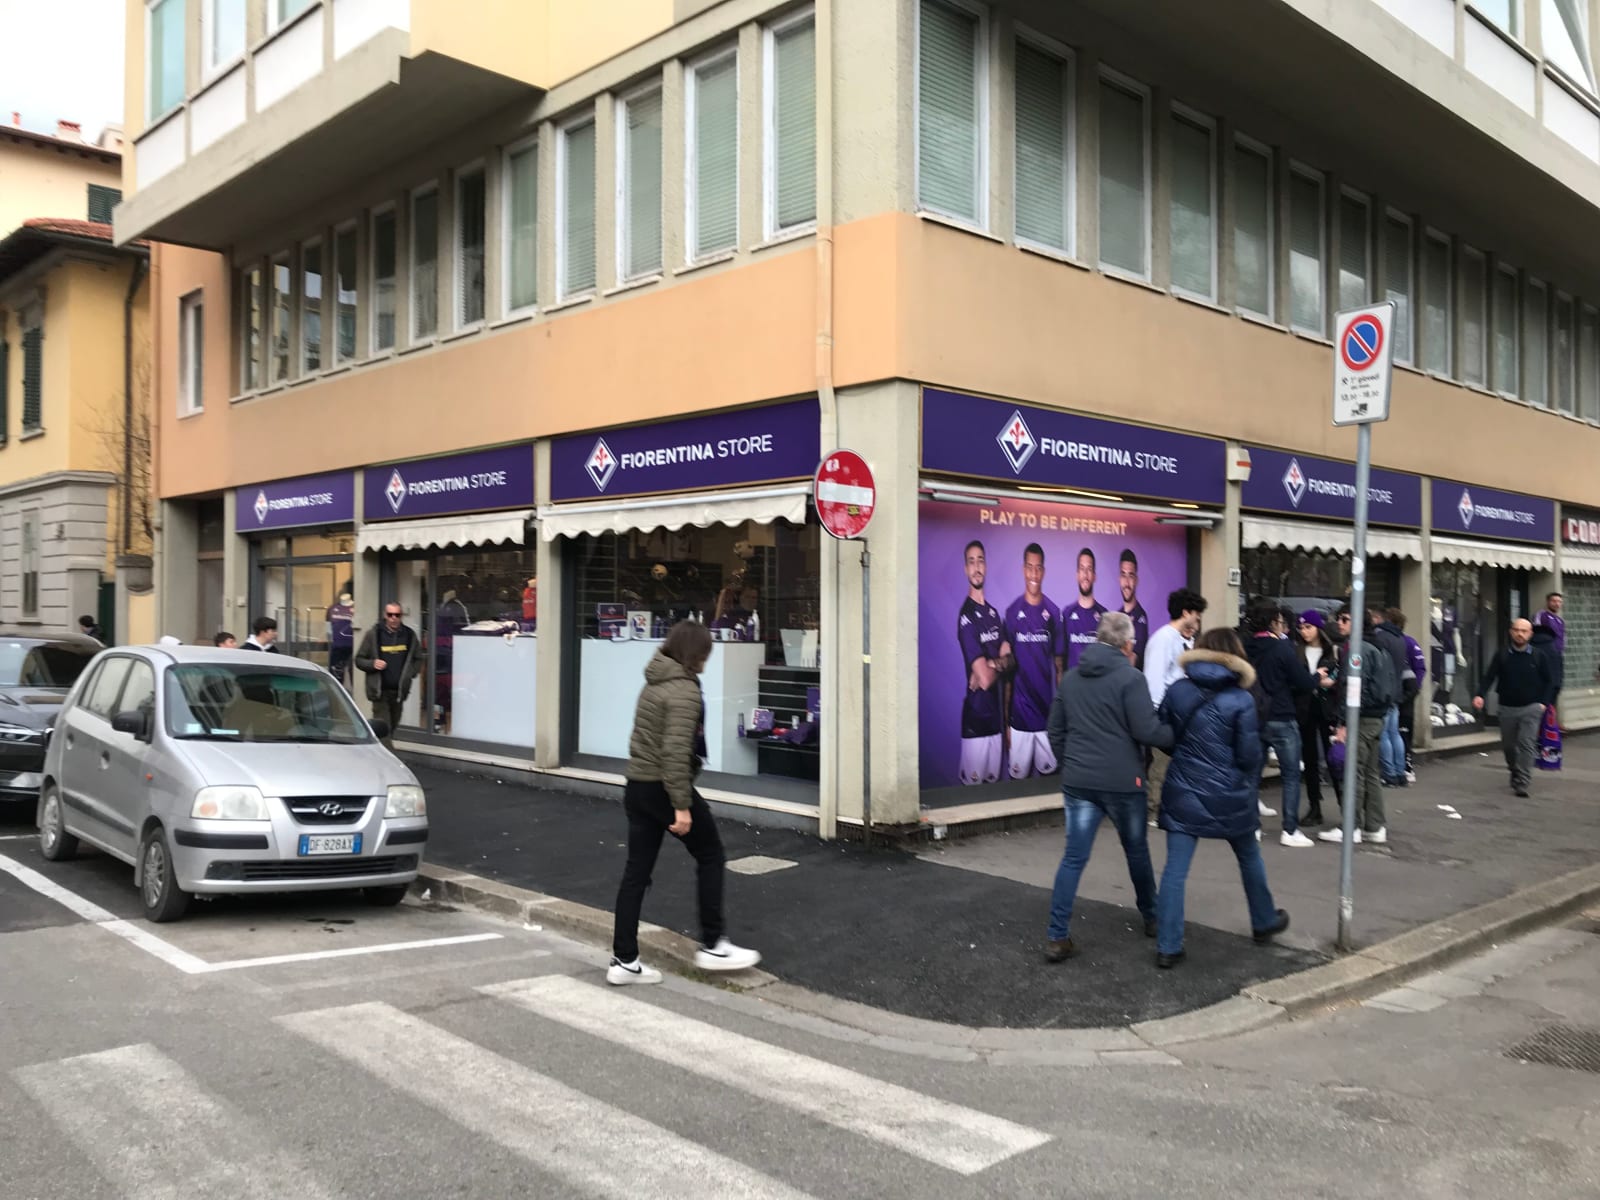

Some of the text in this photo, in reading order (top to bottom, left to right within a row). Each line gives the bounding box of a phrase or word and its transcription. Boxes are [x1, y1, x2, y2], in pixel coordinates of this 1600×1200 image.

[620, 434, 773, 470] FIORENTINA STORE
[1040, 437, 1178, 474] FIORENTINA STORE
[408, 471, 507, 496] FIORENTINA STORE
[1308, 478, 1358, 499] FIORENTIN
[269, 492, 333, 511] FIORENTINA STORE
[980, 509, 1127, 536] PLAY TO BE DIFFERENT
[1475, 504, 1535, 525] FIORENTINA STORE
